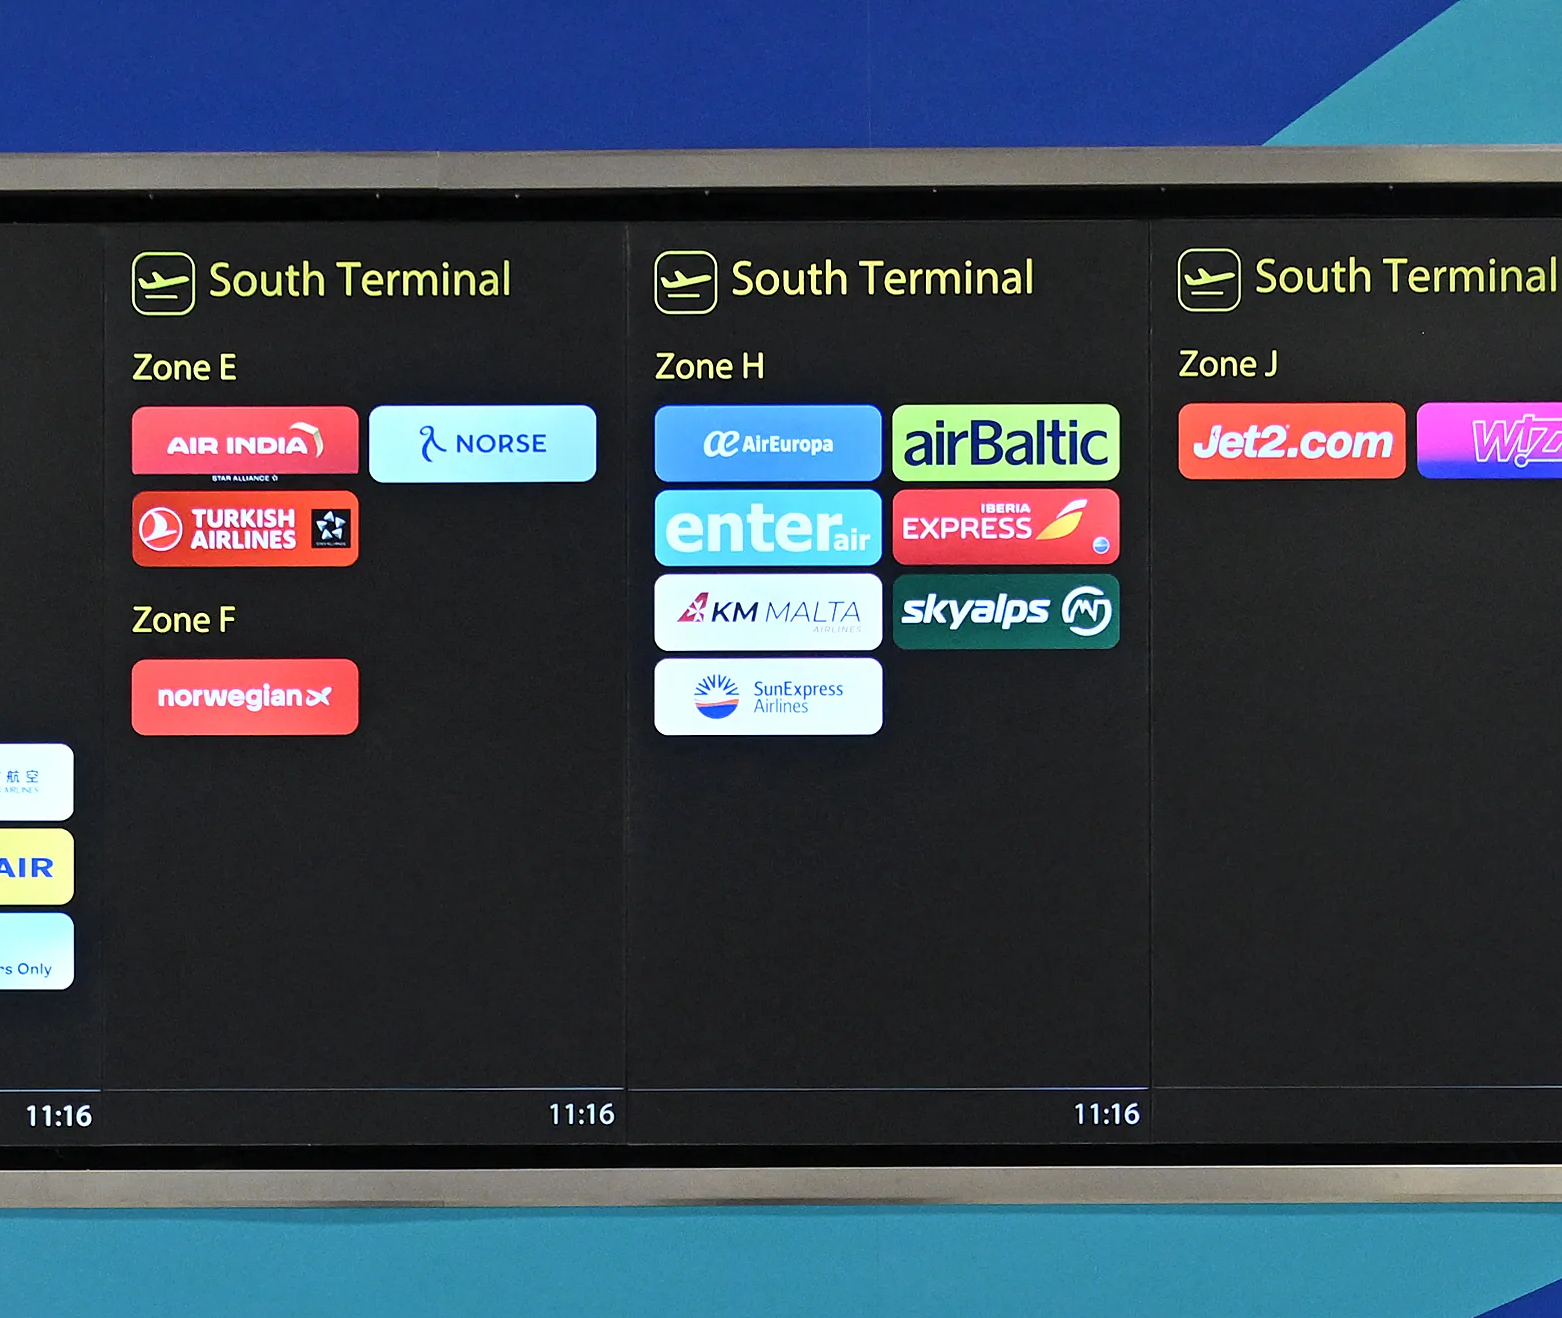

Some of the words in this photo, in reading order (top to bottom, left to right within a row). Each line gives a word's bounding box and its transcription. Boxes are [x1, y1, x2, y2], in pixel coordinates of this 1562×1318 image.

[210, 261, 324, 296] South
[336, 260, 509, 296] Terminal
[733, 259, 847, 295] South
[859, 258, 1032, 295] Terminal
[1256, 257, 1370, 292] South
[1383, 257, 1556, 292] Terminal
[133, 354, 210, 380] Zone
[221, 354, 236, 380] E
[656, 353, 733, 379] Zone
[744, 352, 763, 378] H
[1179, 350, 1256, 376] Zone
[1265, 350, 1276, 376] J
[167, 437, 218, 454] AIR
[227, 437, 308, 455] INDIA
[457, 434, 546, 453] NORSE
[742, 435, 834, 456] AirEuropa
[904, 420, 1108, 466] airBaltic
[1194, 425, 1394, 458] Jet2.com
[211, 473, 233, 483] STAR
[234, 473, 270, 483] ALLIANCE
[981, 503, 1031, 513] IBERIA
[192, 509, 295, 531] TURKISH
[903, 517, 1032, 540] EXPRESS
[191, 527, 296, 549] AIRLINES
[133, 606, 210, 632] Zone
[221, 606, 235, 632] F
[712, 602, 758, 622] KM
[766, 602, 860, 622] MALTA
[902, 593, 1051, 629] skyalps
[812, 625, 863, 634] AIRLINES
[158, 683, 302, 712] norwegian
[755, 681, 843, 701] SunExpress
[754, 697, 808, 713] Airlines
[18, 963, 51, 978] Only
[27, 1105, 92, 1126] 11:16
[550, 1103, 614, 1124] 11:16
[1075, 1103, 1139, 1124] 11:16
